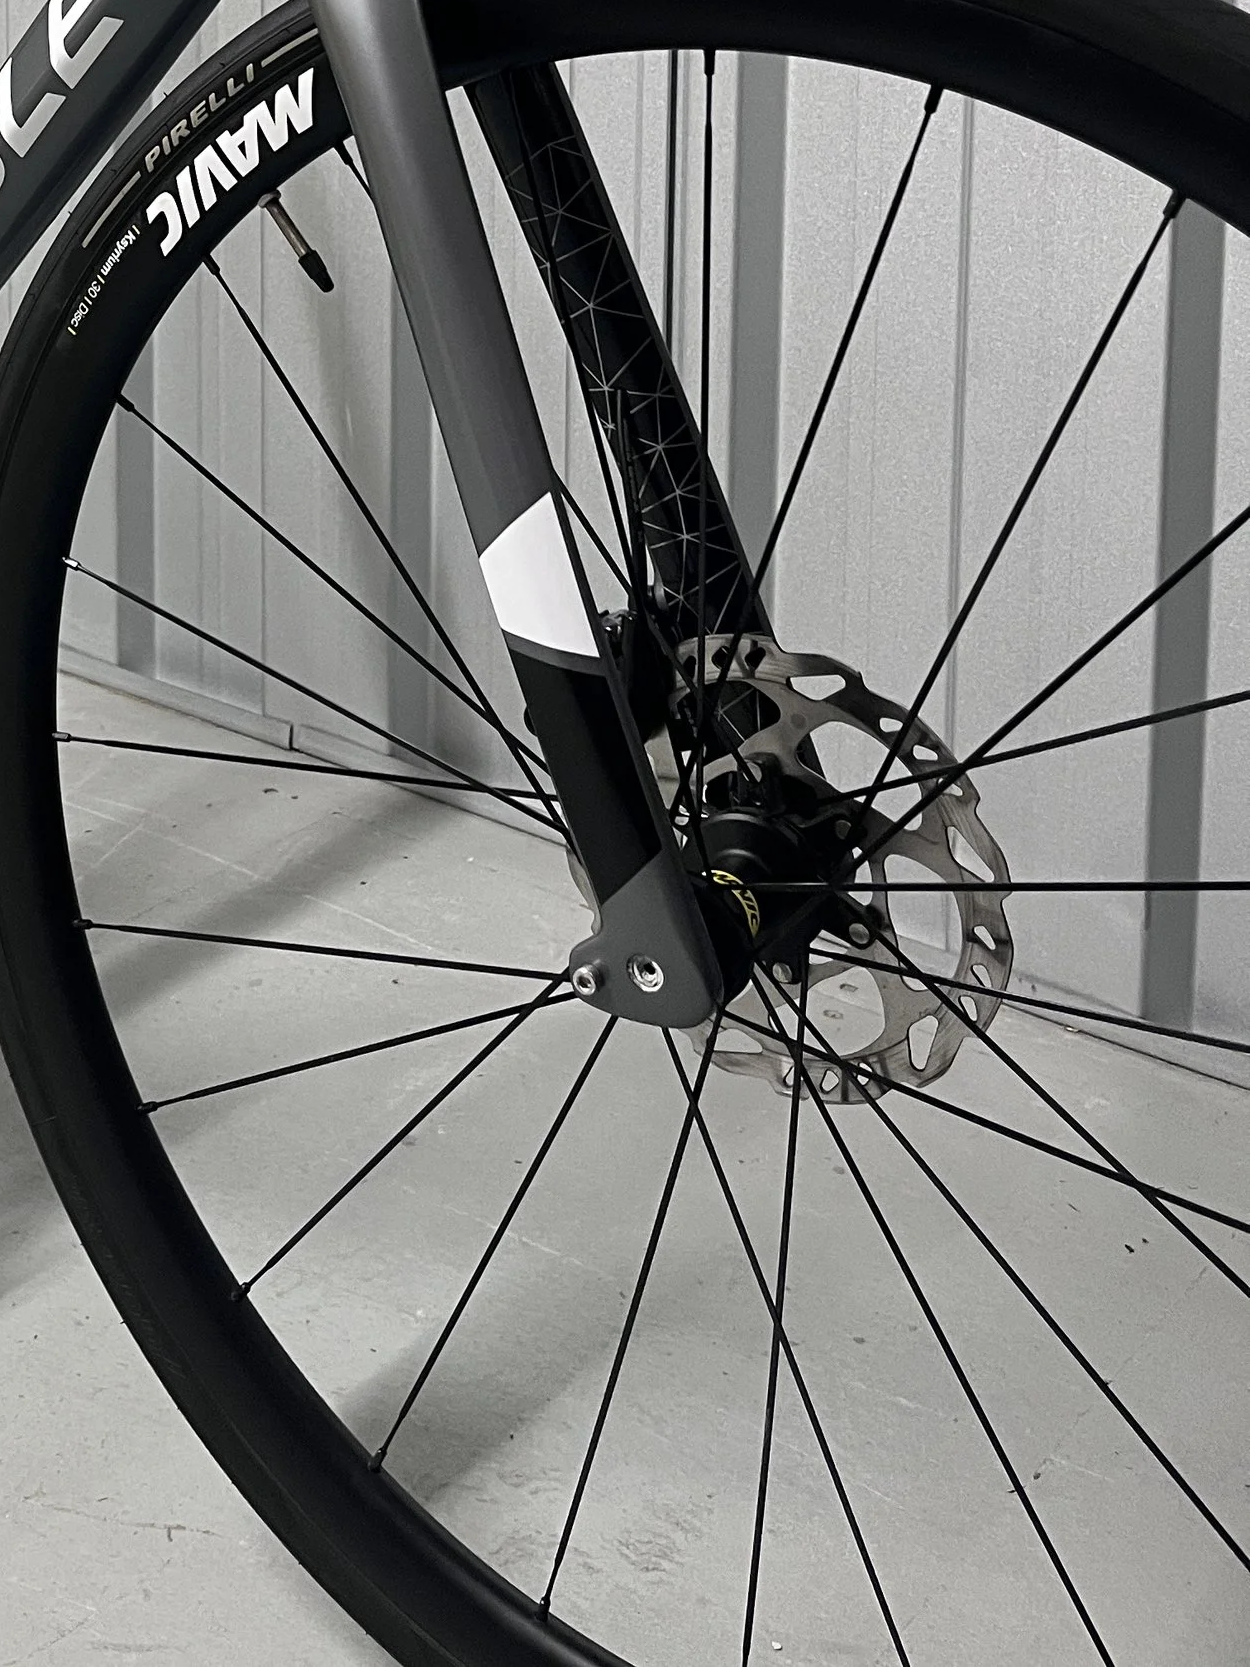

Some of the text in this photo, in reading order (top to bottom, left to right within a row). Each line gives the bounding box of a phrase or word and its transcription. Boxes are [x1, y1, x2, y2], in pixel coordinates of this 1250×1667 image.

[144, 62, 255, 173] PIRELLI
[145, 66, 314, 257] MAVIC
[70, 229, 136, 328] Ksyrium 30 Disc
